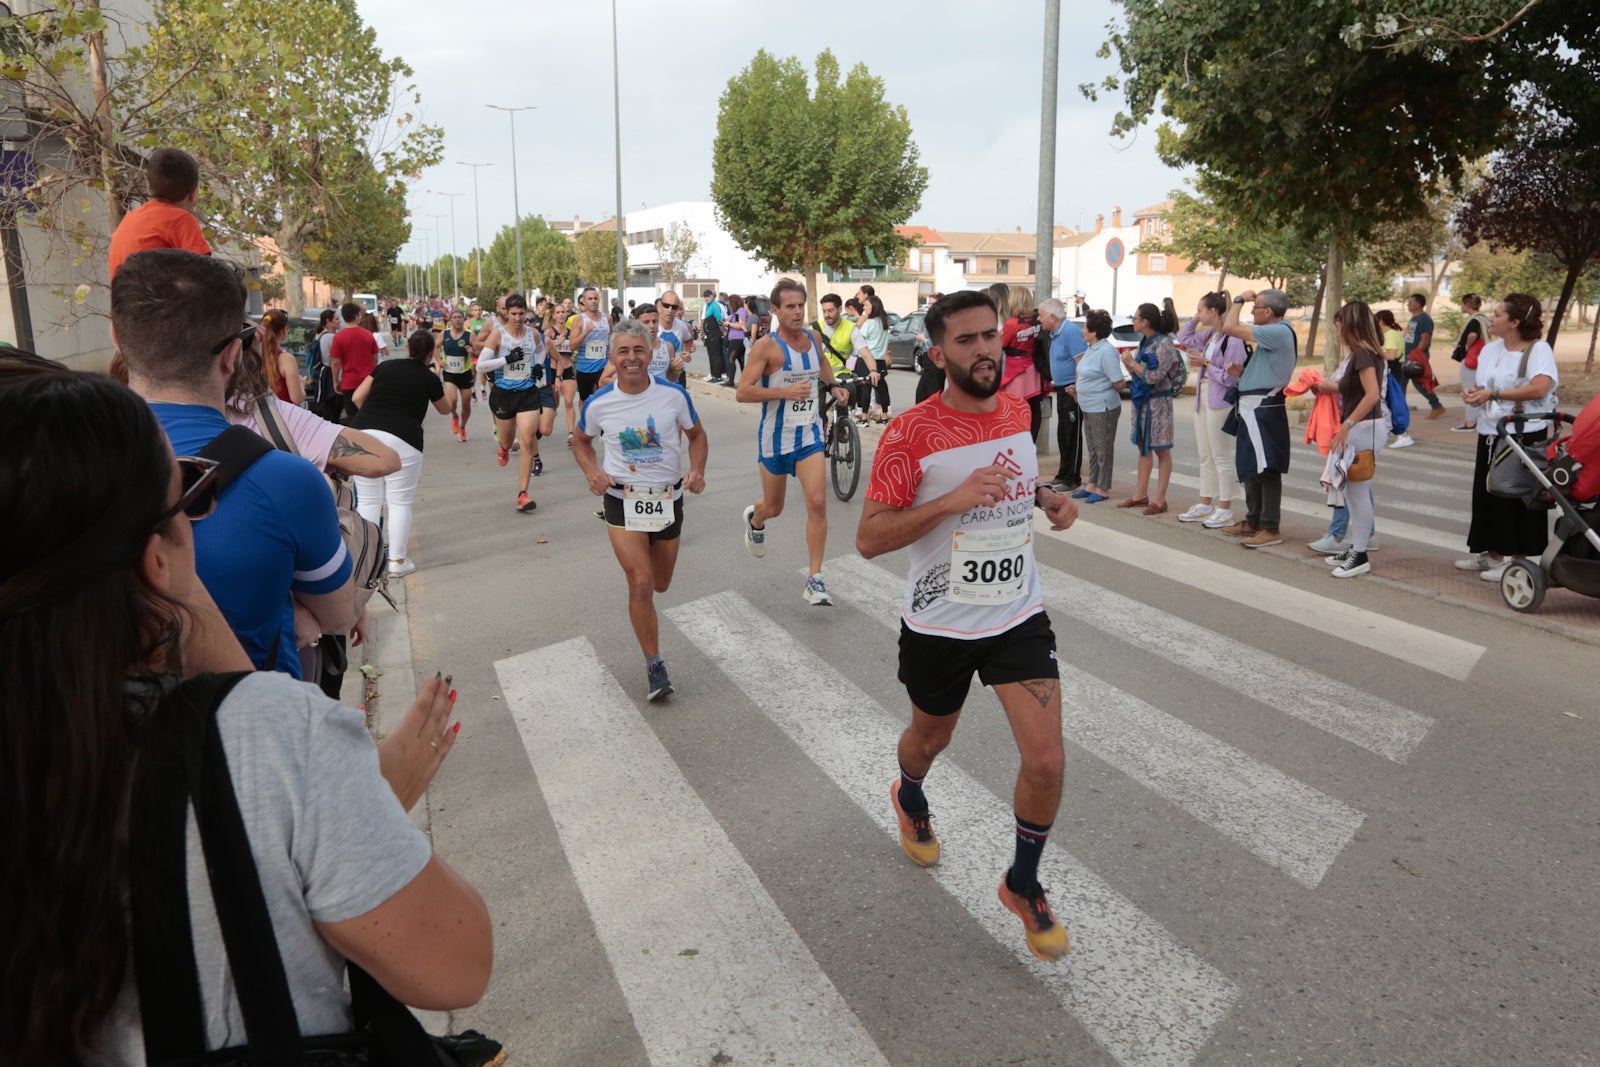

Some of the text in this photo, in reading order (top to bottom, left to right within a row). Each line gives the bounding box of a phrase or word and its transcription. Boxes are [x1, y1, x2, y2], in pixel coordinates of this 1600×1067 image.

[509, 363, 526, 372] 847
[792, 399, 814, 412] 627
[634, 500, 664, 515] 684
[960, 507, 1003, 525] CARAS
[962, 554, 1024, 583] 3080
